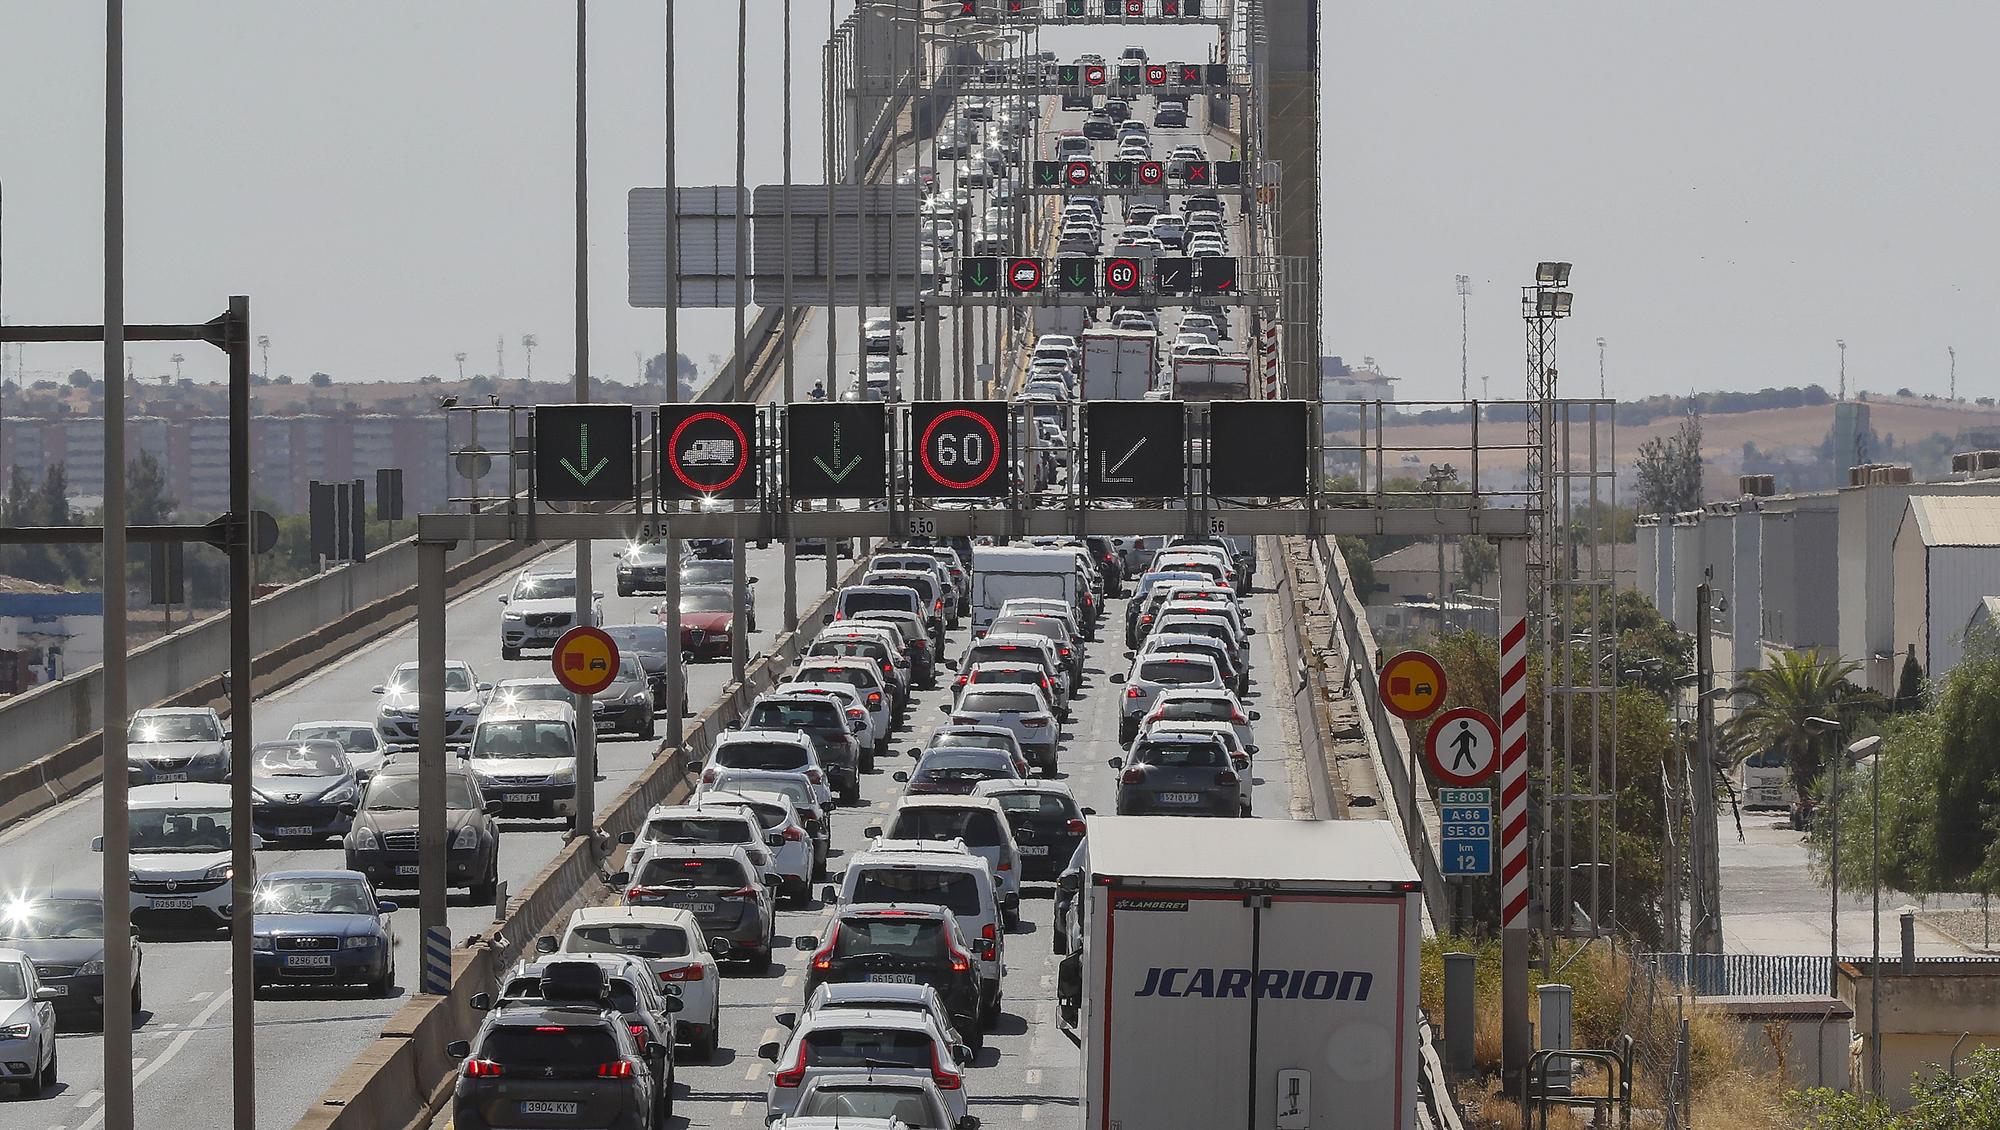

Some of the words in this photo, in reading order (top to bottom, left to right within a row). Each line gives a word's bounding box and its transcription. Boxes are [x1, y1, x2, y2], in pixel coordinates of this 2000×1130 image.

[1150, 70, 1161, 79] 60
[1144, 168, 1157, 178] 60
[1112, 268, 1131, 282] 60
[937, 433, 982, 466] 60
[1446, 793, 1484, 802] E-803
[1452, 810, 1480, 820] A-66
[1447, 826, 1485, 836] SE-30
[1459, 843, 1473, 852] km
[1457, 856, 1475, 870] 12
[1129, 900, 1188, 909] LAMBERET
[872, 974, 893, 983] 6615
[1134, 967, 1374, 1001] JCARRION
[528, 1102, 553, 1112] 3904
[556, 1102, 576, 1113] KKY
